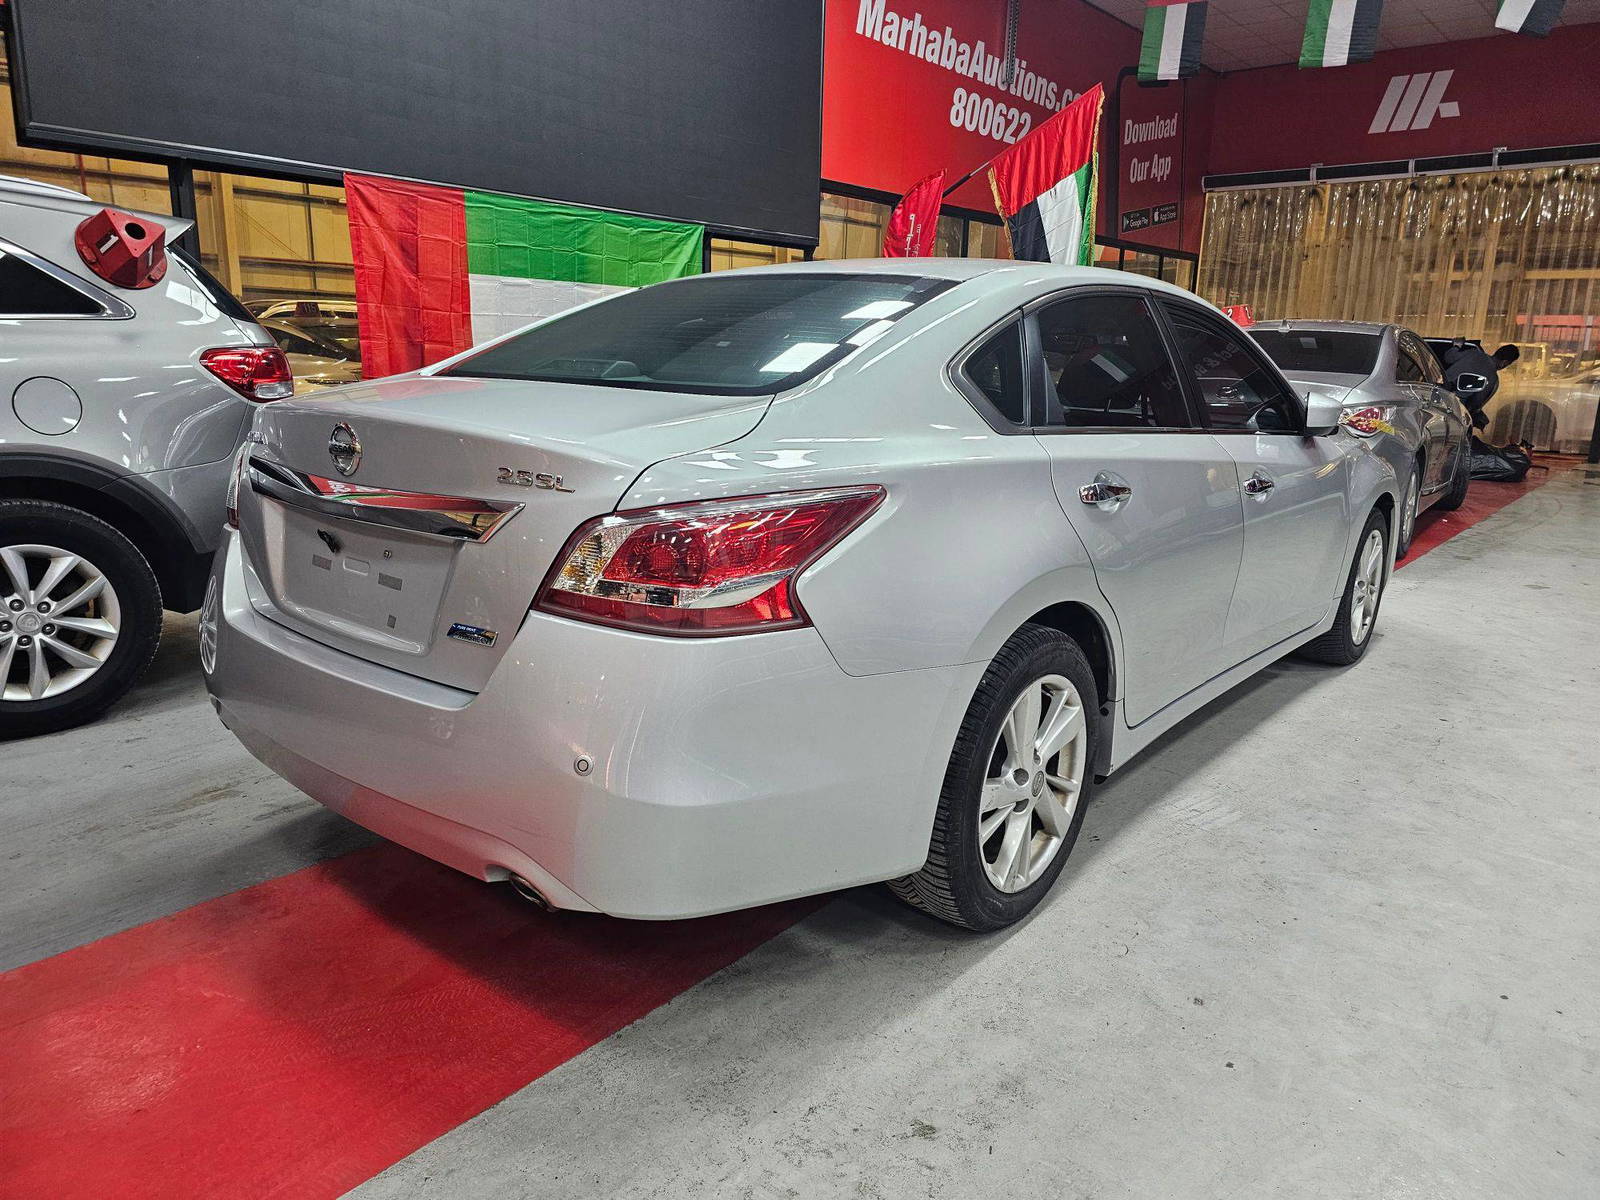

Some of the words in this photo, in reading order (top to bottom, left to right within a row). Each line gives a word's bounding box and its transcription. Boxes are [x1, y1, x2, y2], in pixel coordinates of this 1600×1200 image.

[1124, 112, 1178, 145] Download
[1130, 157, 1150, 184] Our
[1150, 153, 1171, 183] App
[99, 234, 119, 254] 1
